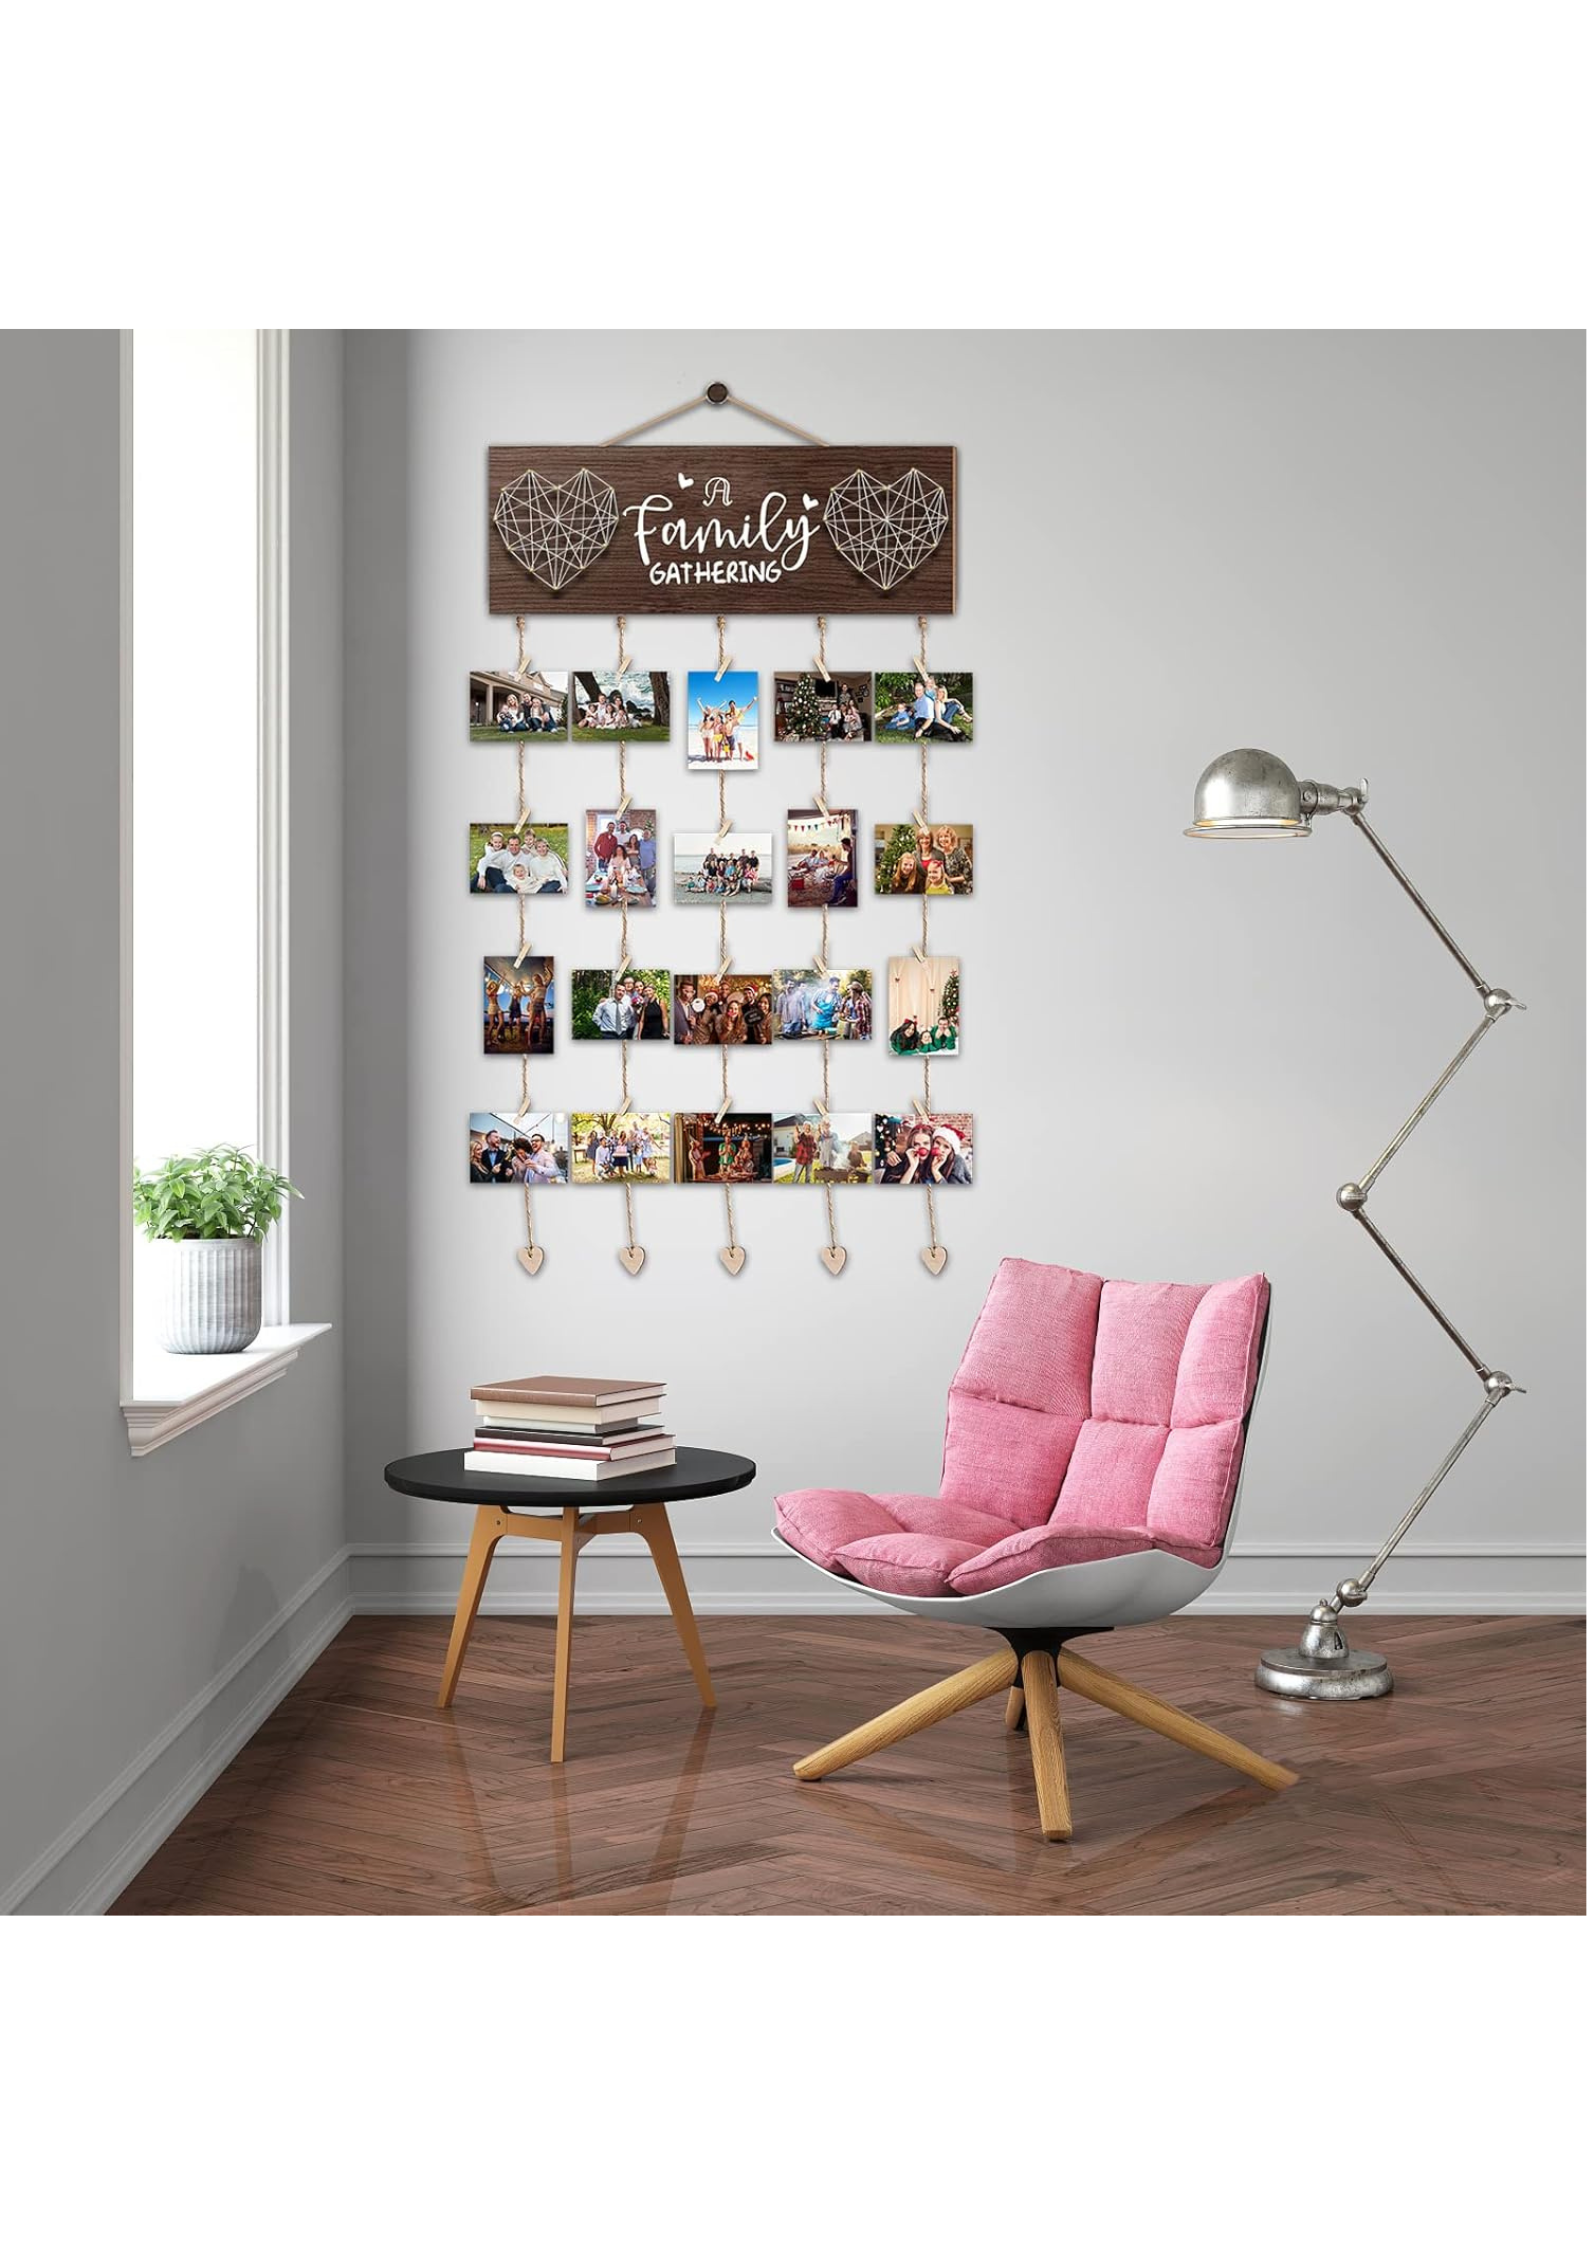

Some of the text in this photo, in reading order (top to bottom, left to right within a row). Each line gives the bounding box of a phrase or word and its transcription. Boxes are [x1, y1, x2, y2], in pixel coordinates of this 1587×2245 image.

[702, 476, 733, 507] A
[622, 491, 821, 571] Family
[649, 560, 782, 586] GATHERING
